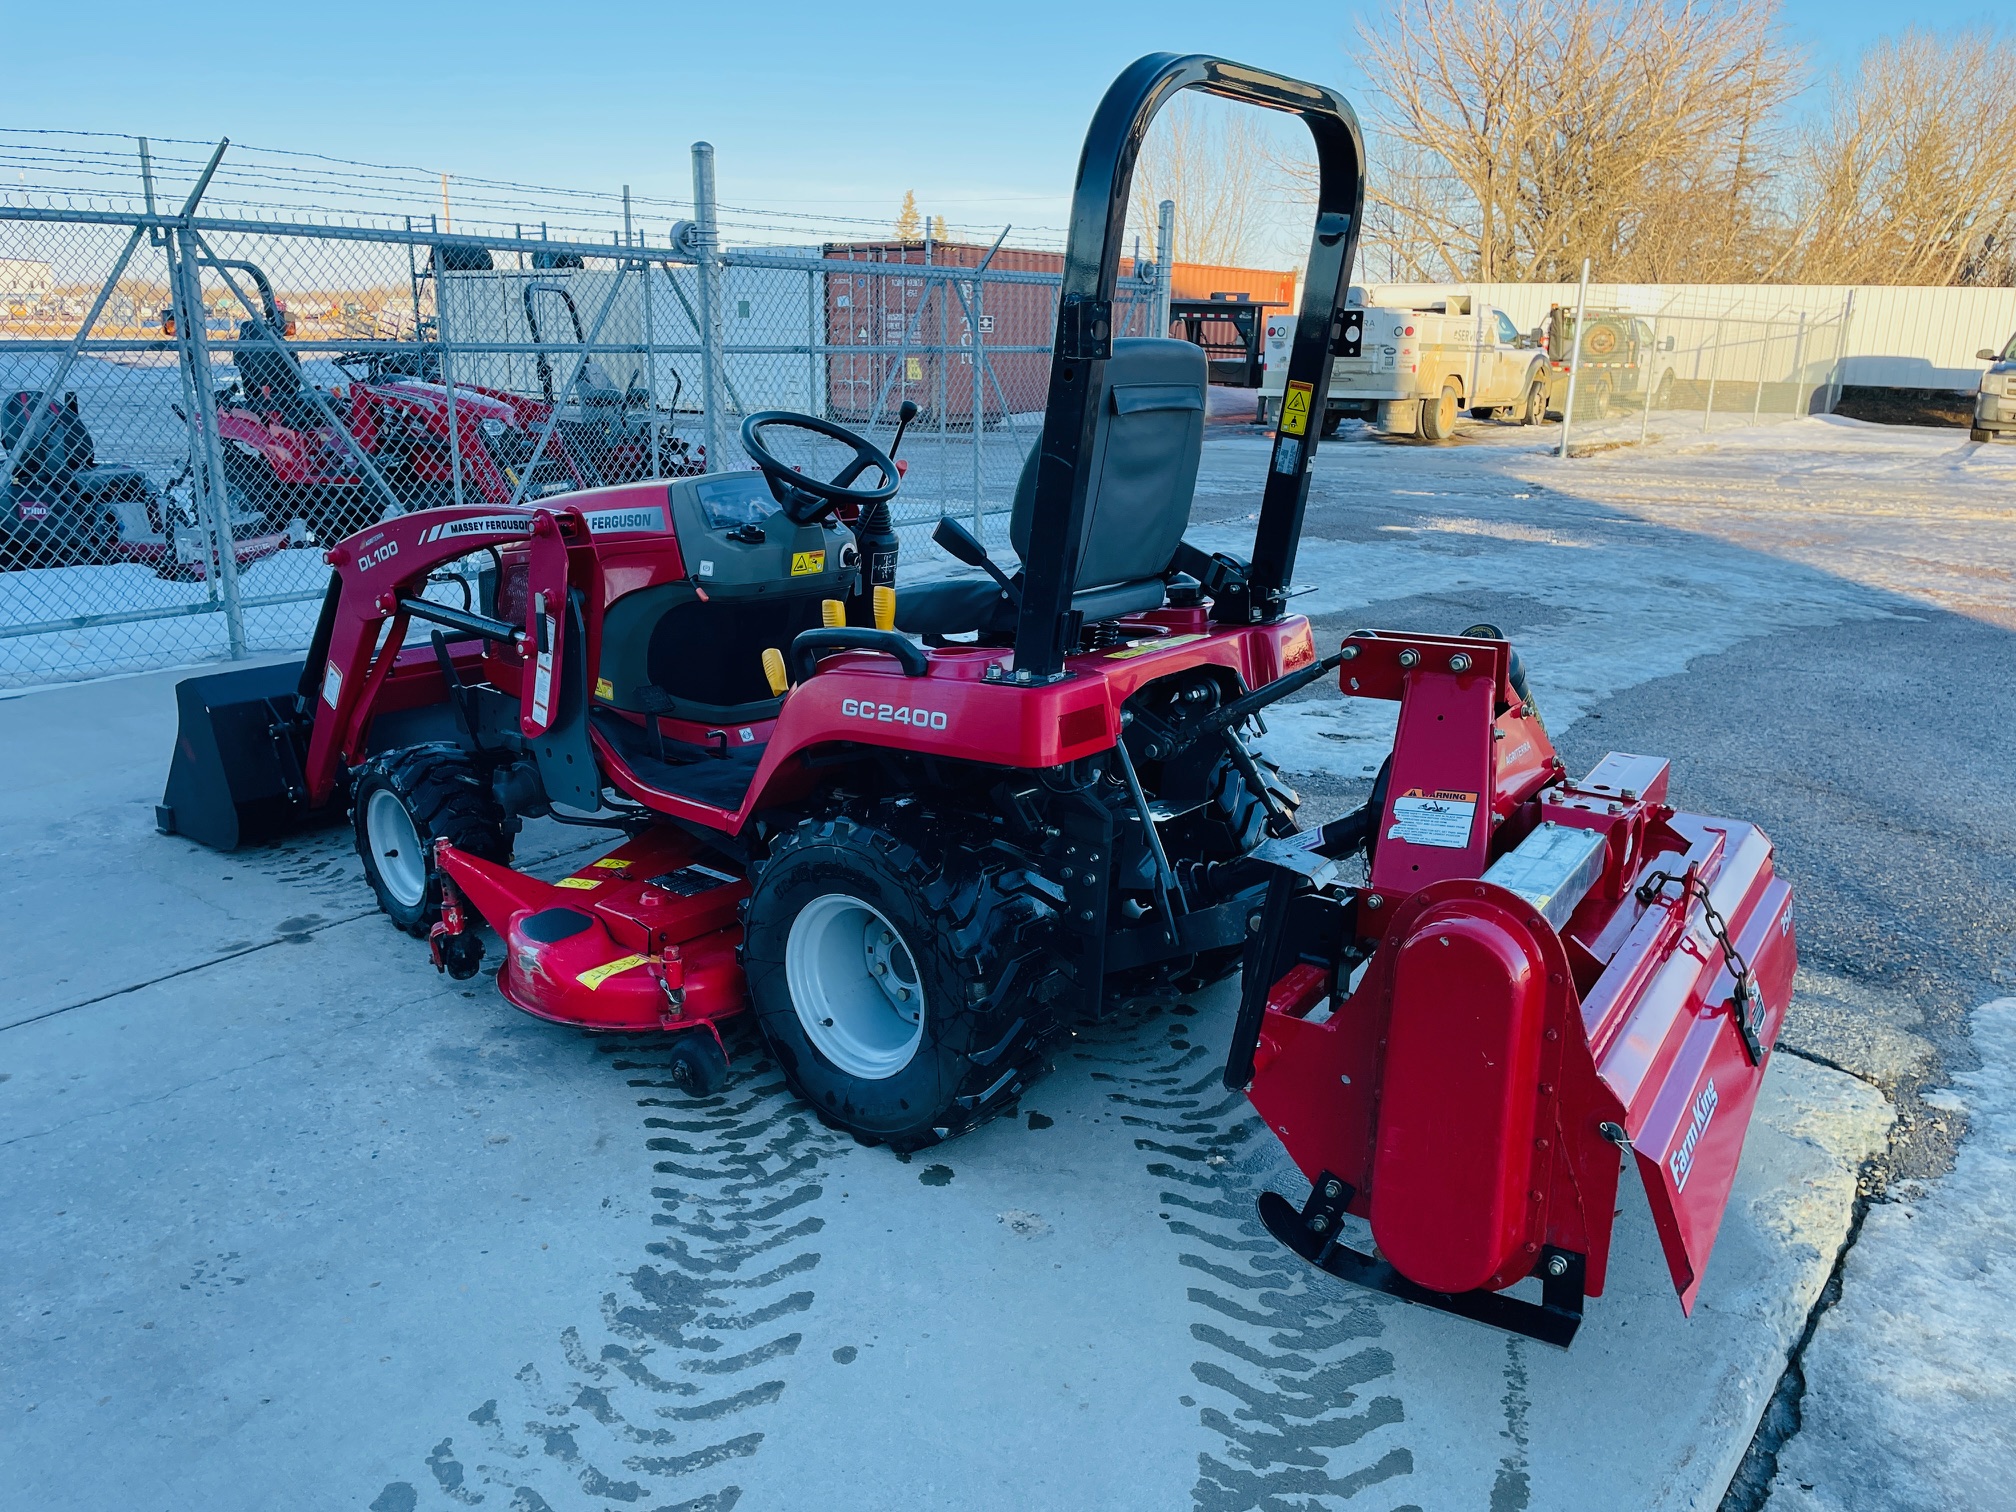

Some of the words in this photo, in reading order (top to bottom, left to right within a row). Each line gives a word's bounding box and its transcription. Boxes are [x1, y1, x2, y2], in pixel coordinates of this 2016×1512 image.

[450, 522, 484, 534] MASSEY
[591, 513, 652, 530] FERGUSON
[357, 540, 400, 573] DL100
[841, 698, 948, 731] GC2400
[1669, 1121, 1699, 1187] Farm
[1691, 1076, 1719, 1132] King
